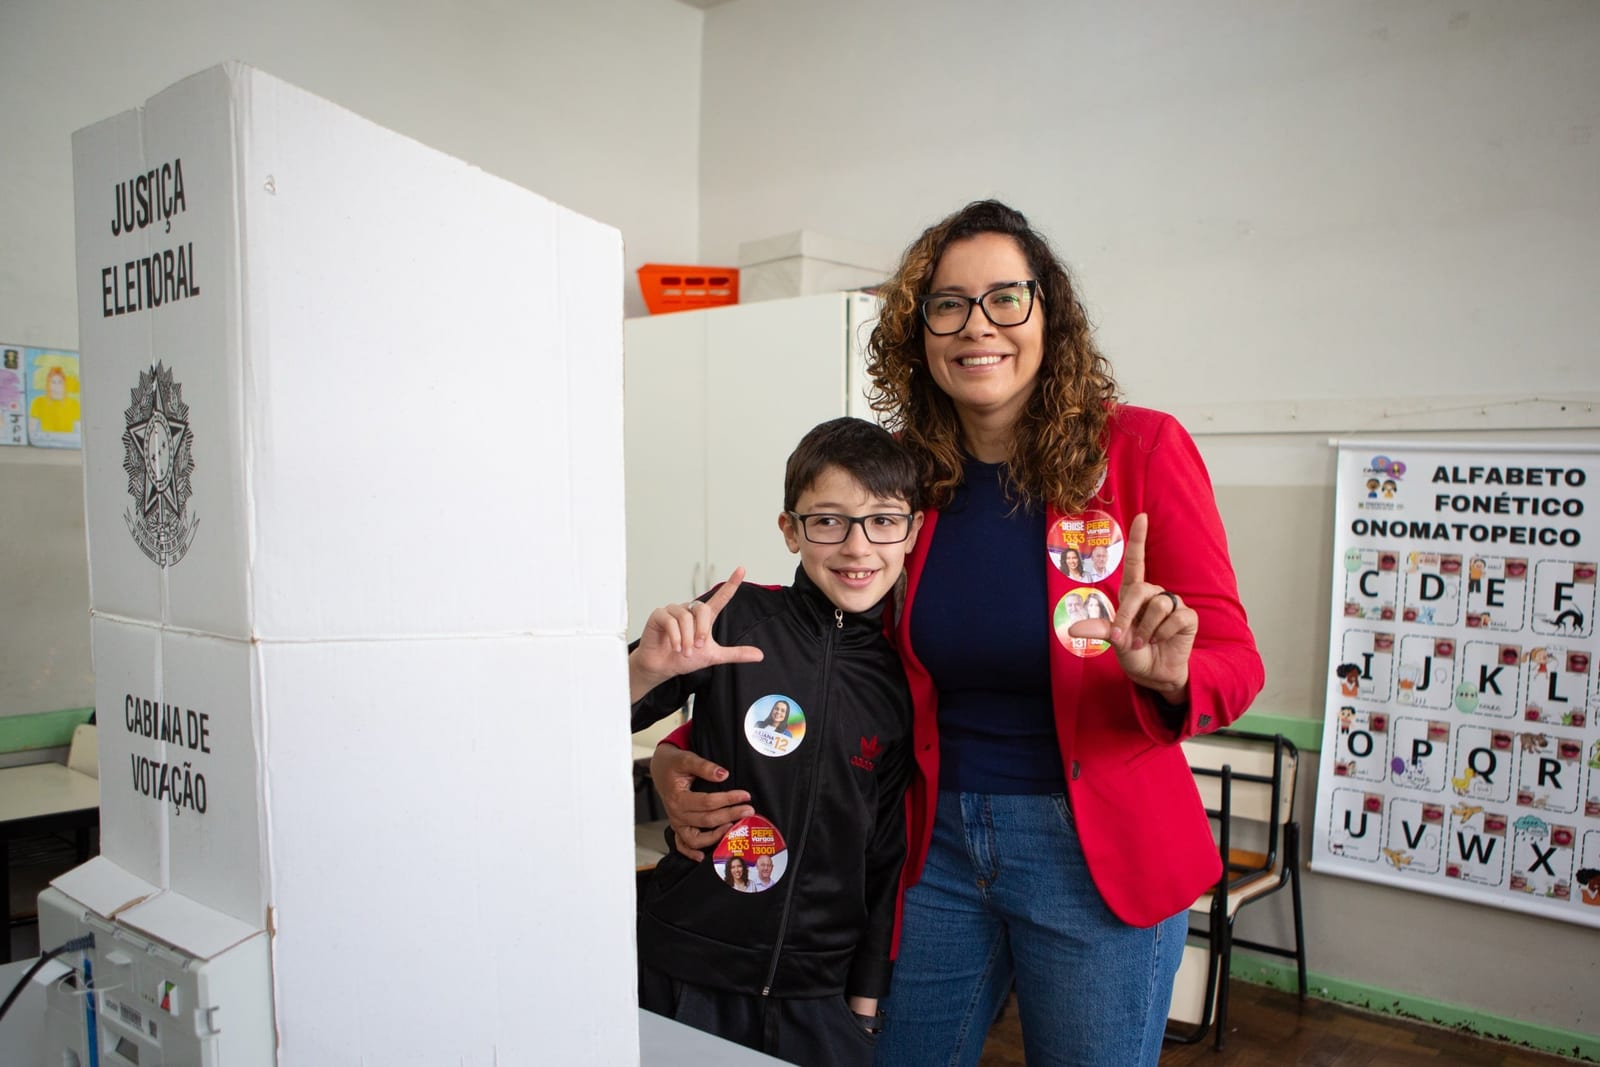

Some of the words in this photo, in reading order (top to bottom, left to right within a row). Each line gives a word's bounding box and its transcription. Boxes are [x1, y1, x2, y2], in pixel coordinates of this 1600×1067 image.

[111, 158, 186, 237] JUSTIÇA
[101, 242, 200, 318] ELEITORAL
[1432, 466, 1587, 488] ALFABETO
[1435, 492, 1585, 517] FONÉTICO
[1062, 531, 1086, 544] 1333
[1087, 520, 1110, 530] PEPE
[1351, 519, 1582, 547] ONOMATOPEICO
[1360, 570, 1379, 598] C
[1420, 573, 1445, 601] D
[1486, 578, 1505, 607] E
[1554, 582, 1574, 611] F
[1361, 652, 1374, 680] I
[1416, 656, 1431, 691] J
[1479, 664, 1504, 695] K
[1548, 671, 1568, 702] L
[125, 693, 183, 747] CABINA
[187, 709, 211, 754] DE
[774, 736, 789, 752] 12
[1348, 730, 1373, 757] O
[1411, 738, 1433, 766] P
[1468, 747, 1497, 785] Q
[1537, 757, 1562, 789] R
[131, 753, 207, 816] VOTAÇÃO
[726, 839, 750, 851] 1333
[751, 829, 774, 837] PEPE
[1344, 810, 1367, 838] U
[1402, 820, 1426, 849] V
[1457, 831, 1496, 864] W
[1527, 842, 1557, 876] X
[752, 846, 776, 855] 13001
